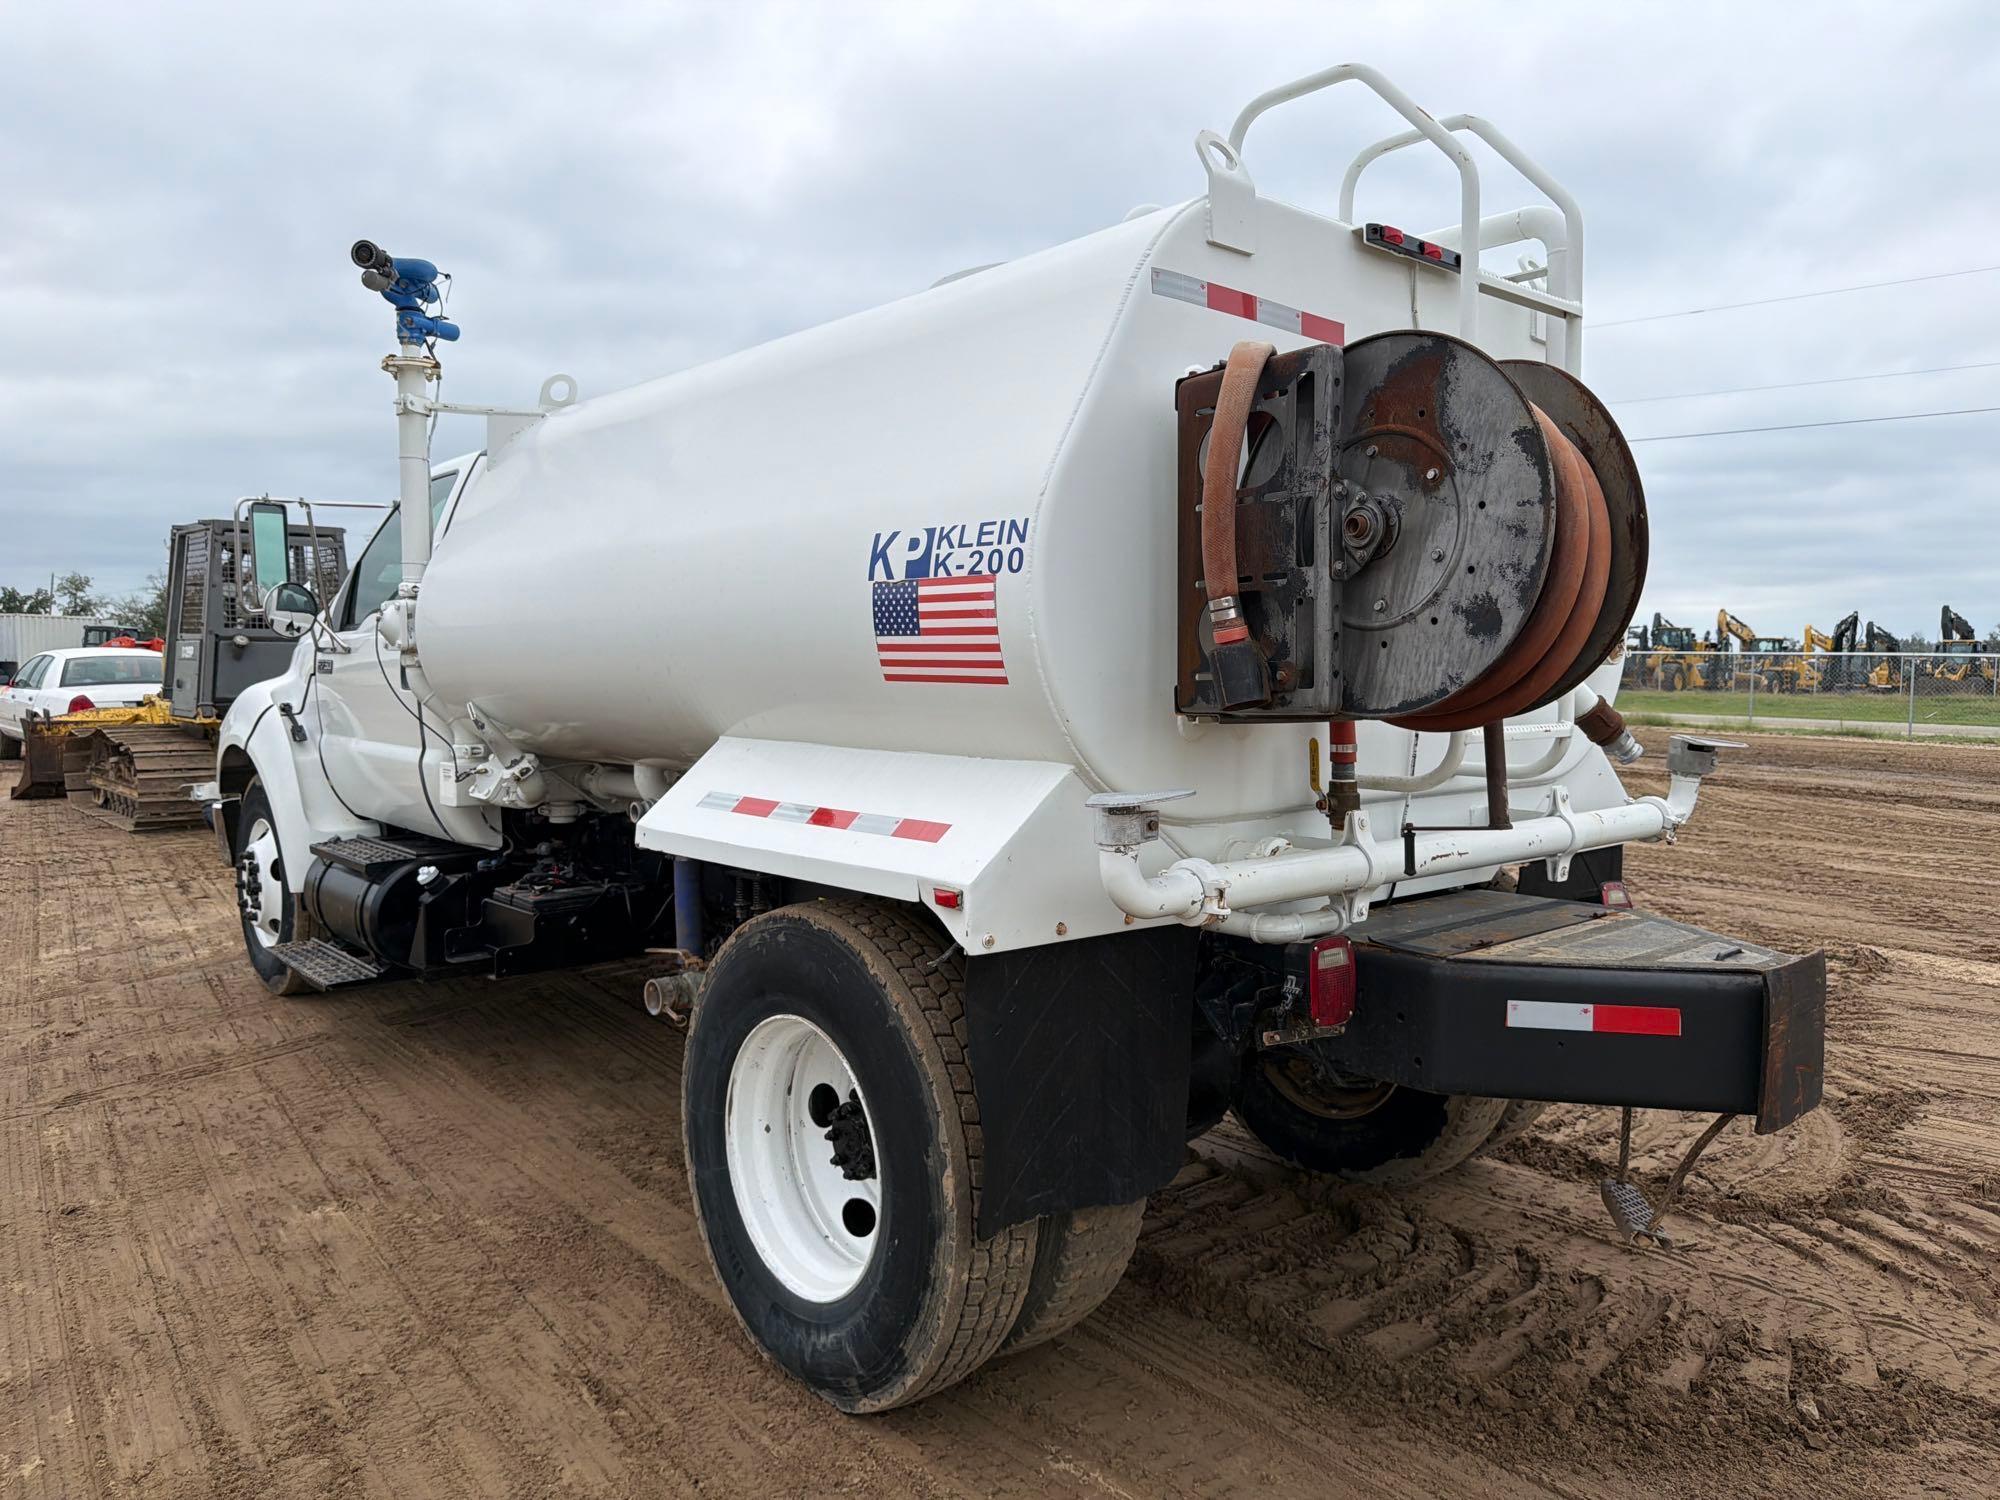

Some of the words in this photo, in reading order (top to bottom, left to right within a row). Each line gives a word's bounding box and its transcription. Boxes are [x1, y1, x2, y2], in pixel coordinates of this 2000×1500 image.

[936, 517, 1029, 550] KLEIN
[868, 528, 937, 581] KP
[933, 547, 1025, 577] K-200
